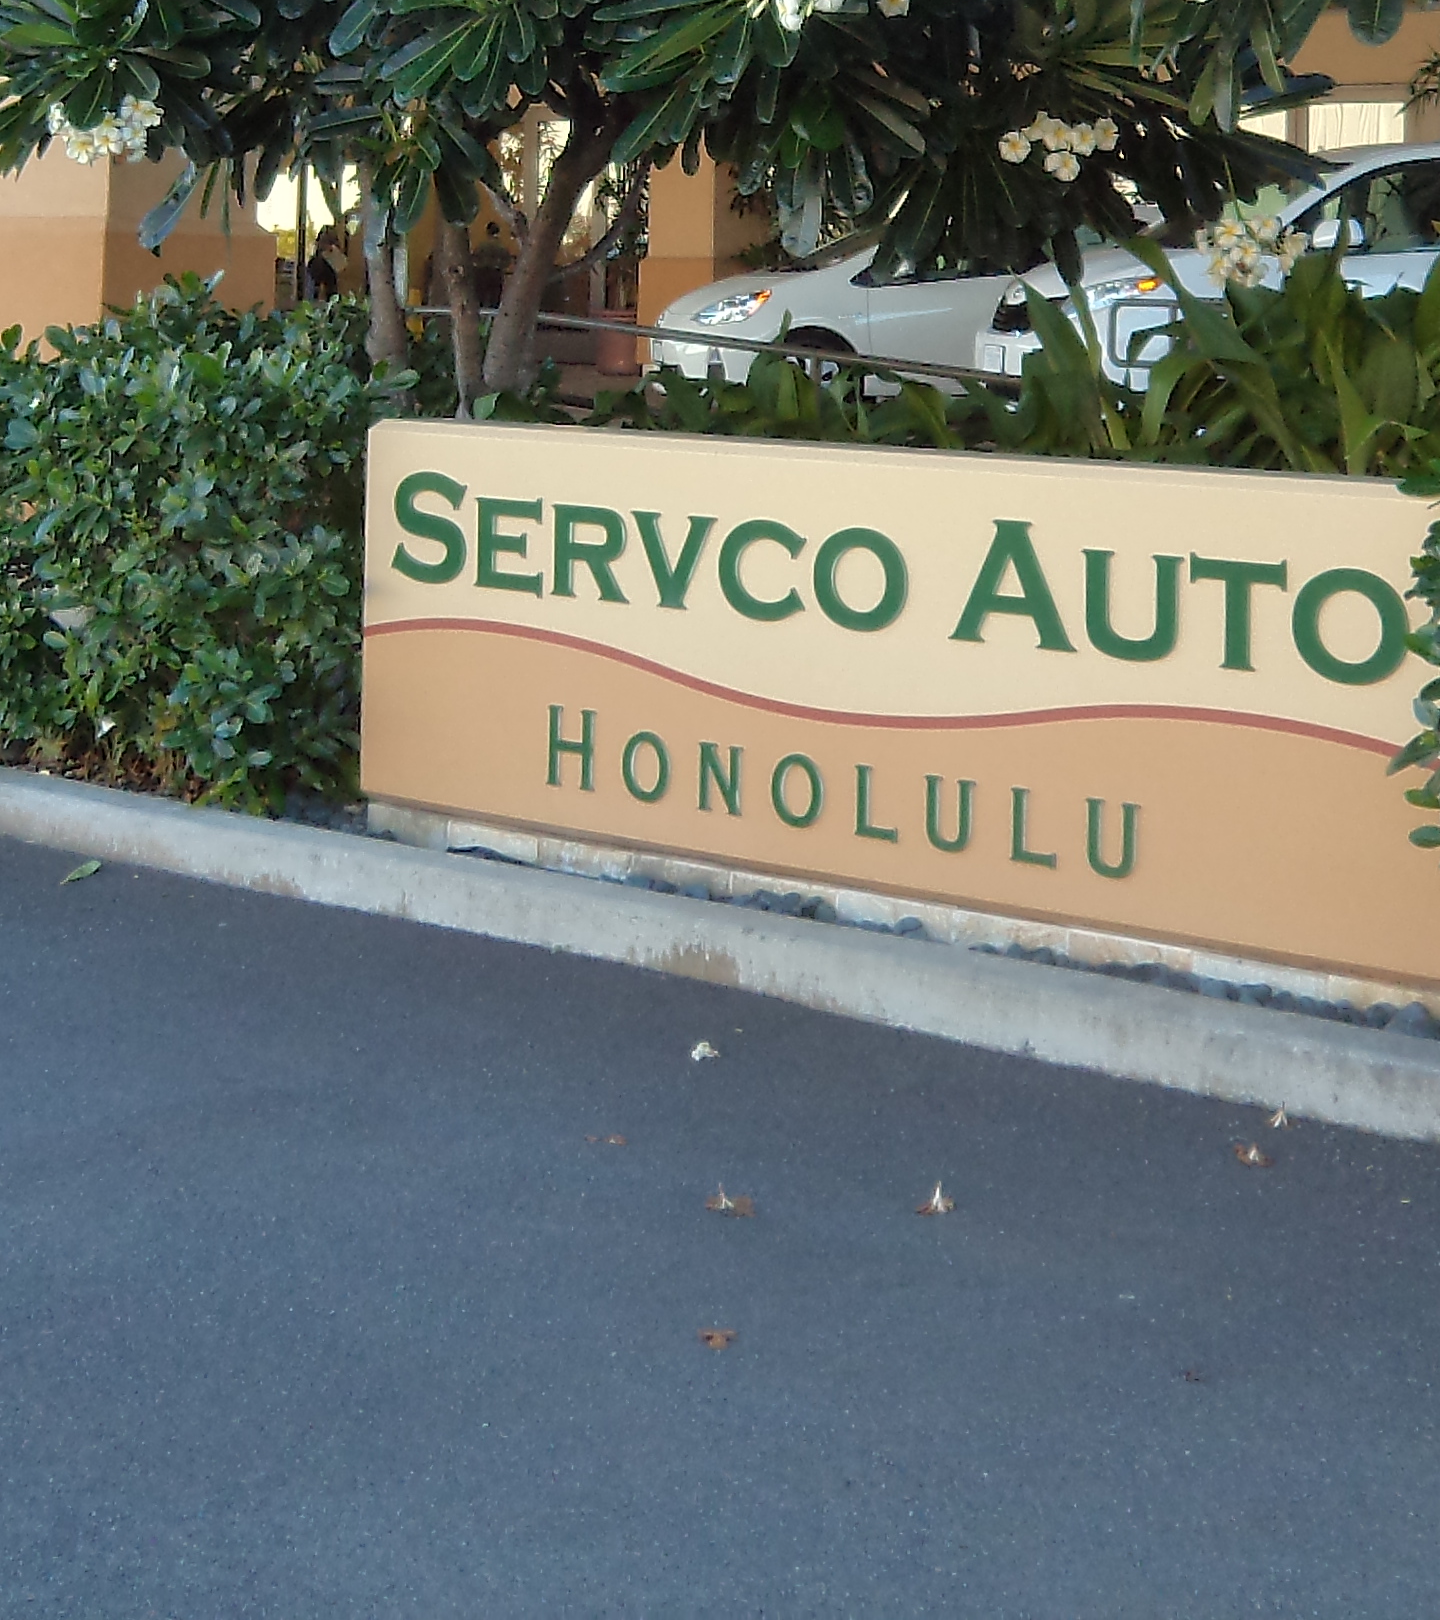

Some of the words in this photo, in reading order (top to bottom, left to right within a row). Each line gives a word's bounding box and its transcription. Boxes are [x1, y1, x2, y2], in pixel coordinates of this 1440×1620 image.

[391, 470, 909, 632] SERVCO
[948, 519, 1409, 686] AUTO
[545, 703, 1141, 880] HONOLULU
